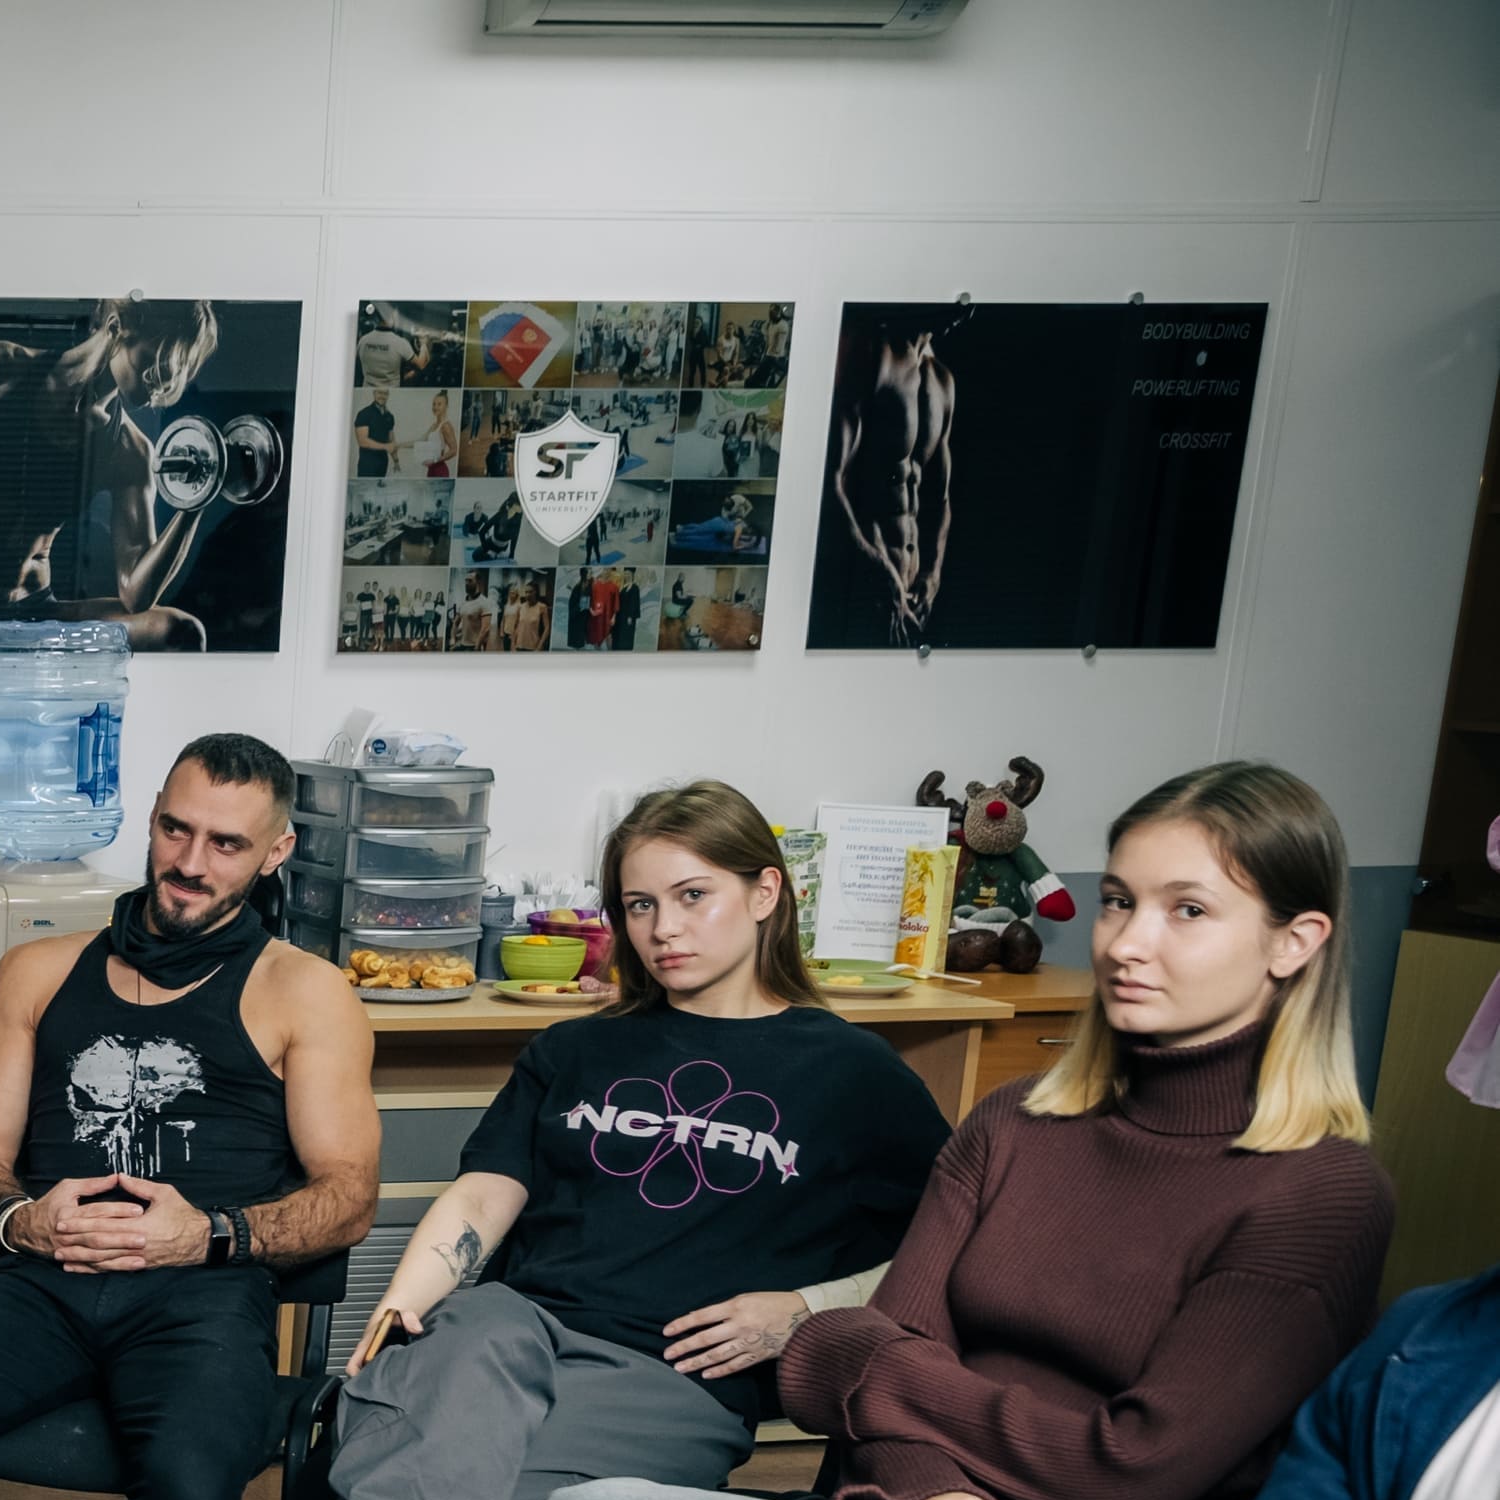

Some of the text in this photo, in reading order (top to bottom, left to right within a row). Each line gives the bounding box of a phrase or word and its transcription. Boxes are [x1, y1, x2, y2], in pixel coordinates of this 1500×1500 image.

[1142, 322, 1251, 340] BODYBUILDING
[1131, 378, 1241, 397] POWERLIFTING
[1159, 431, 1233, 449] CROSSFIT
[536, 441, 601, 480] SF
[529, 491, 599, 502] STARTFIT
[562, 1101, 799, 1183] NCTRN
